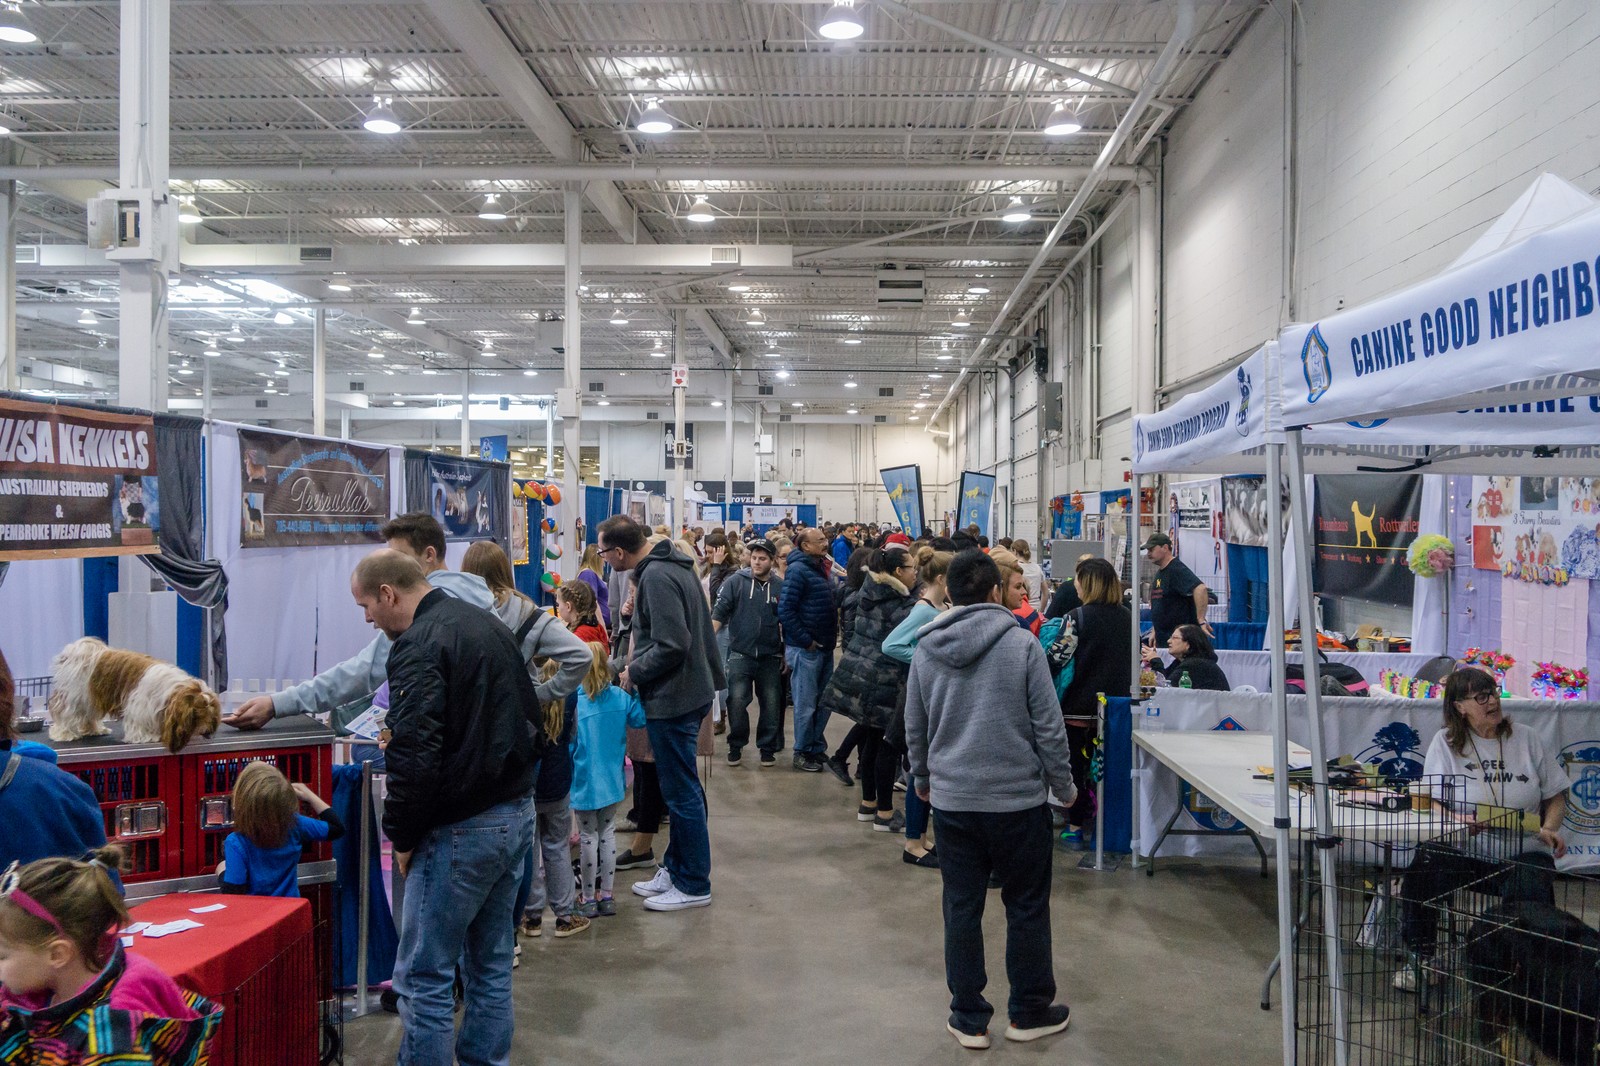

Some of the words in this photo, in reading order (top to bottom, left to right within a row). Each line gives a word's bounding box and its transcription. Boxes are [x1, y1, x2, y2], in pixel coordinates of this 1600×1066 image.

[1350, 318, 1416, 377] CANINE
[1420, 297, 1480, 358] GOOD
[1488, 253, 1600, 340] NEIGHB
[1199, 401, 1230, 437] PROGRAM
[0, 417, 55, 464] LISA
[58, 422, 149, 470] KENNELS
[60, 480, 109, 498] SHEPHERDS
[55, 504, 64, 518] &
[0, 523, 50, 541] PEMBROKE
[51, 524, 81, 540] WELSH
[80, 523, 112, 539] CORGIS
[1482, 759, 1506, 770] GEE
[1483, 772, 1514, 783] HAW
